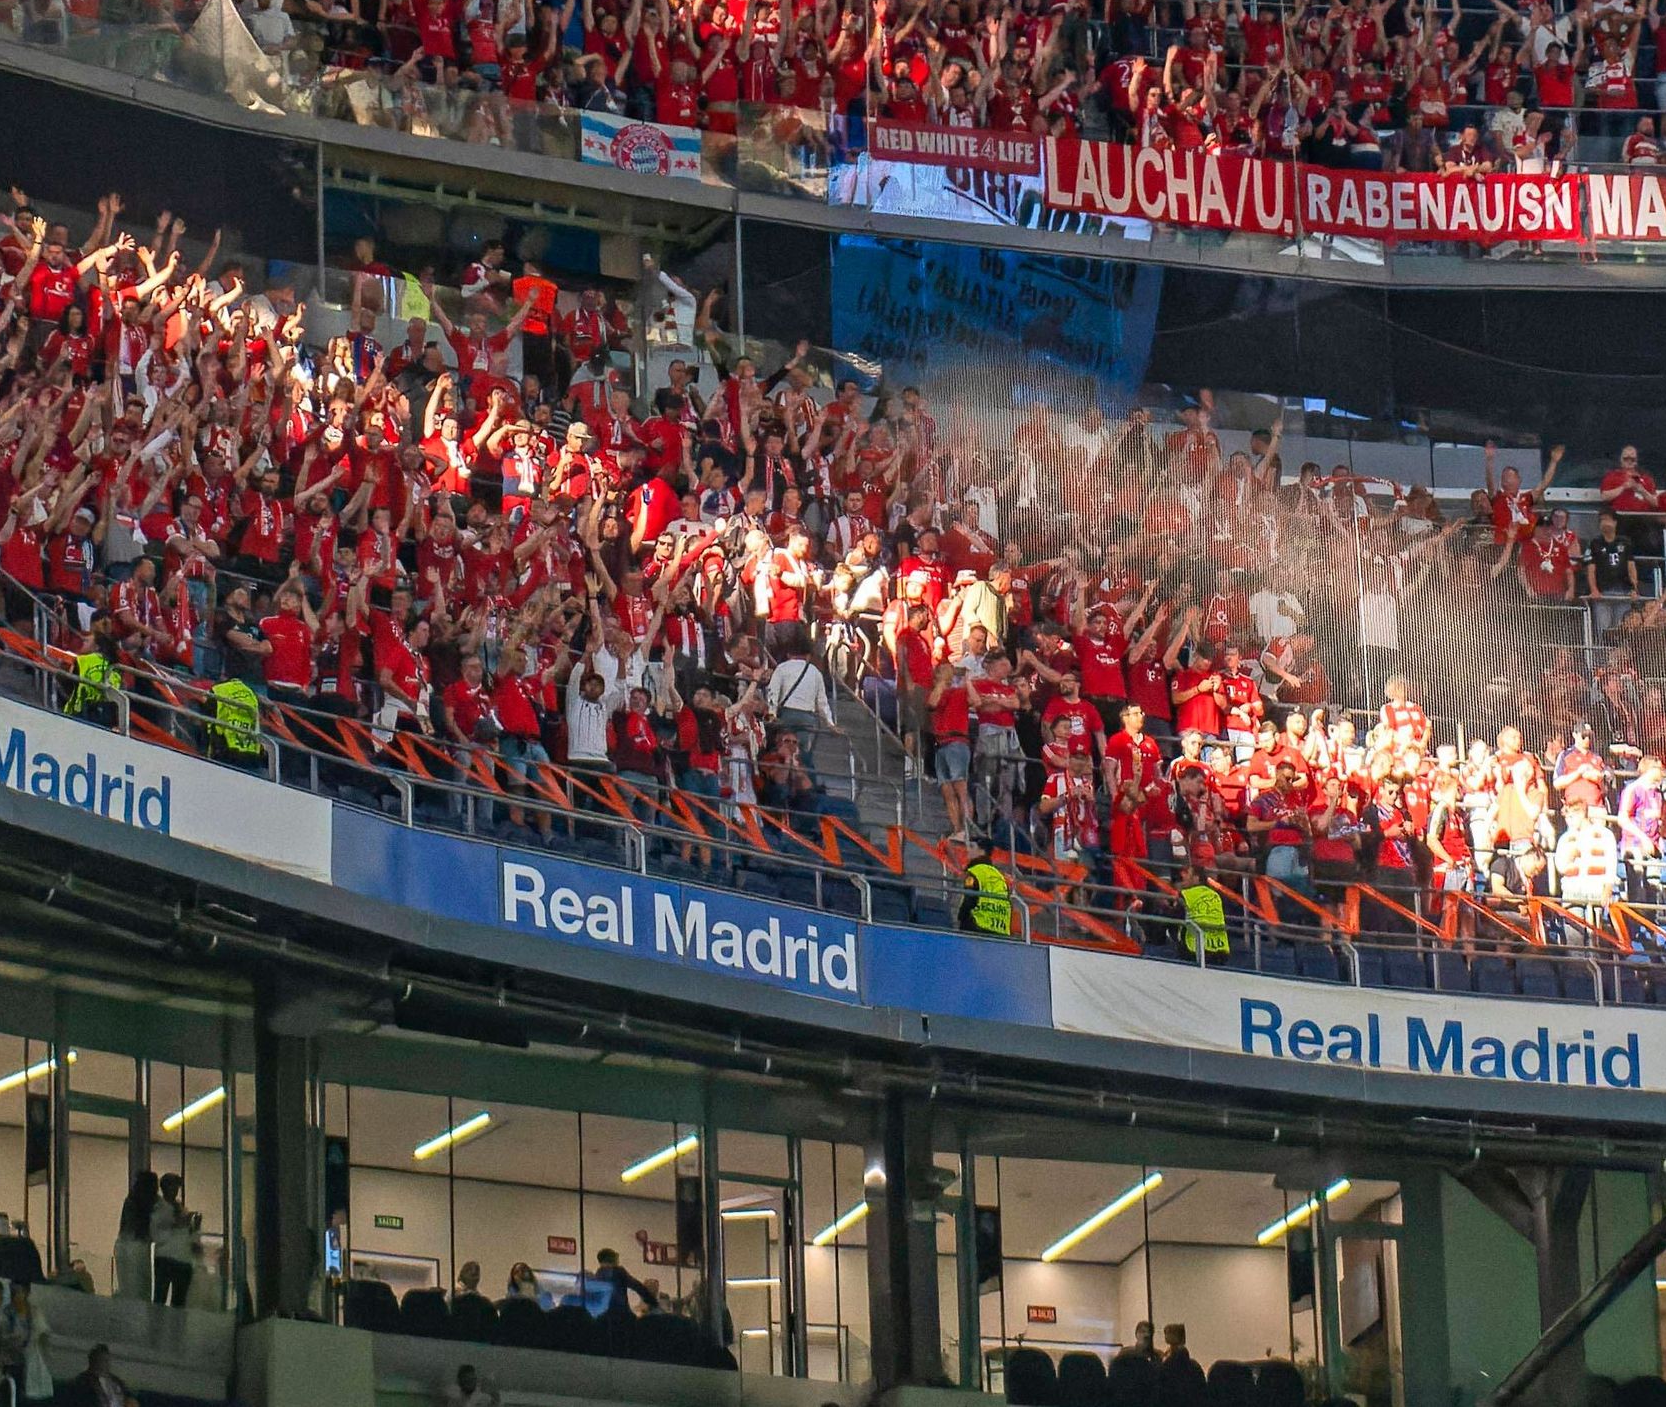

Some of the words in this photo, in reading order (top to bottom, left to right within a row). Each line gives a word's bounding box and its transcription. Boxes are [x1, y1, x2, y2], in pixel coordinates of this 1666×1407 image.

[876, 126, 913, 151] RED
[916, 130, 979, 158] WHITE
[981, 137, 997, 161] 4
[998, 140, 1035, 164] LIFE
[1046, 136, 1294, 234] LAUCHA/U.
[1307, 173, 1573, 232] RABENAU/SN
[503, 861, 633, 946] Real
[654, 893, 858, 992] Madrid
[1239, 997, 1381, 1069] Real
[1406, 1016, 1642, 1089] Madrid
